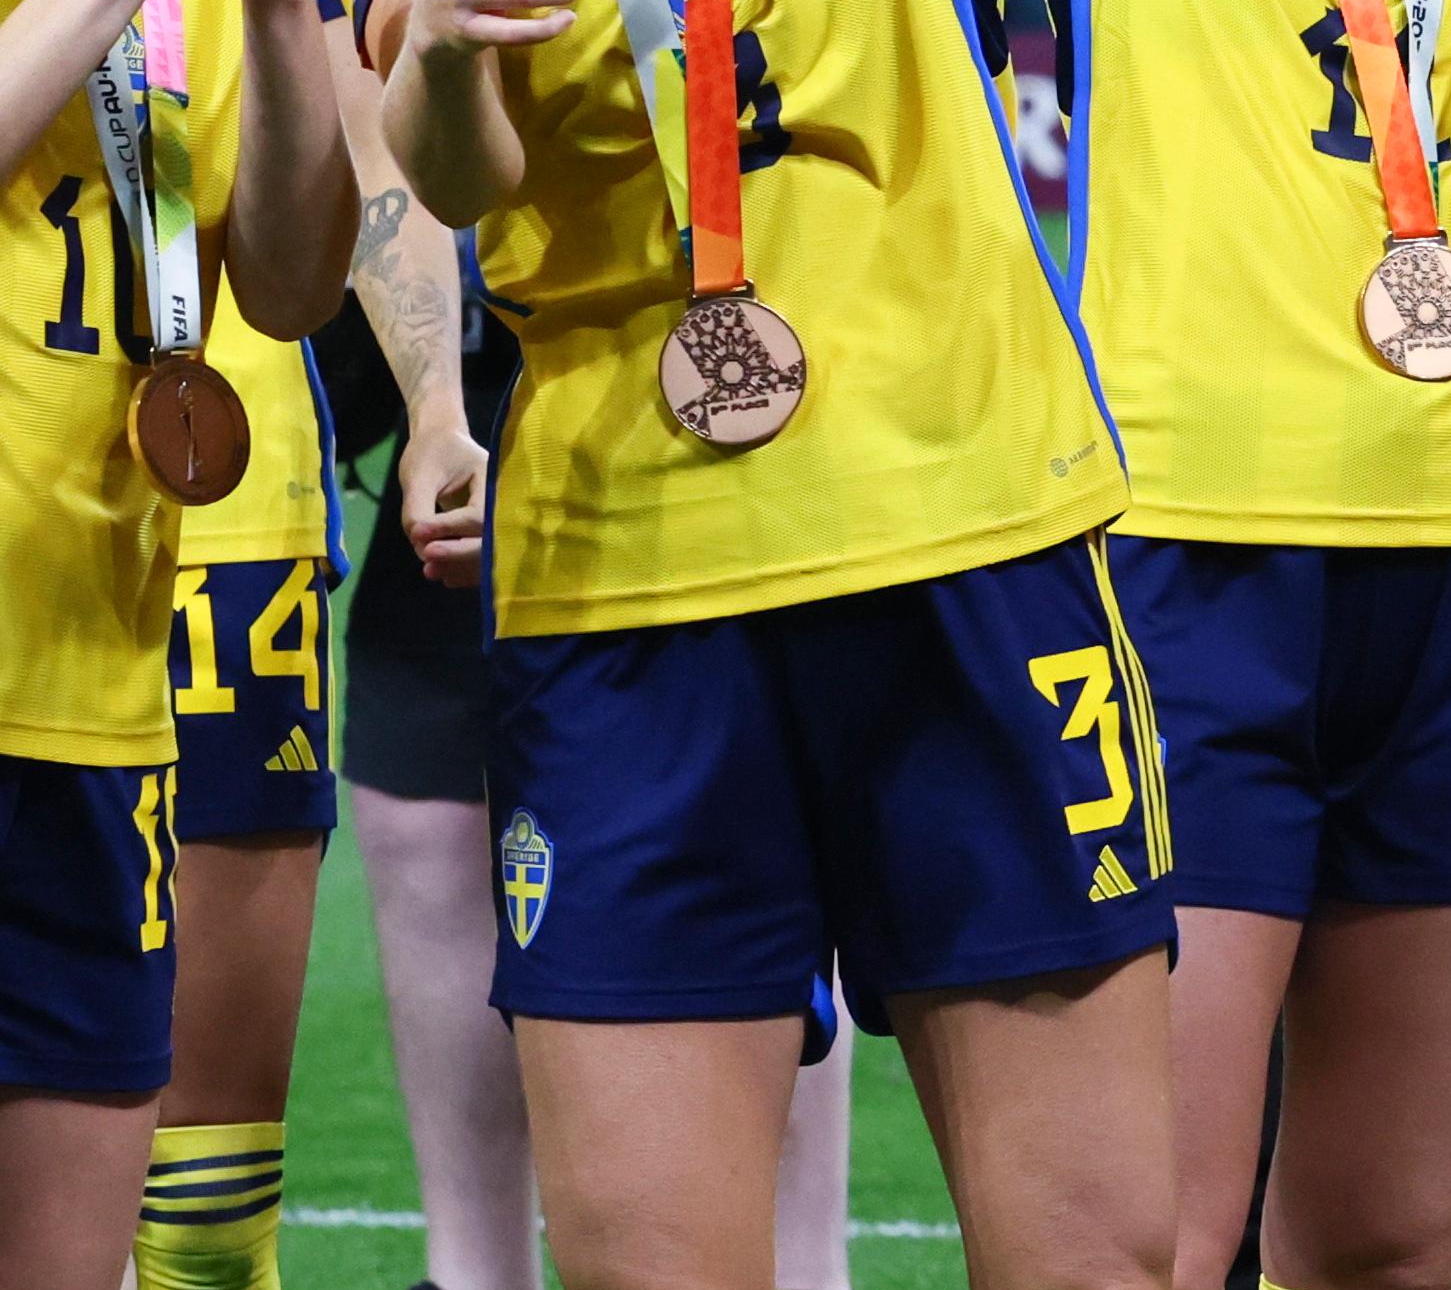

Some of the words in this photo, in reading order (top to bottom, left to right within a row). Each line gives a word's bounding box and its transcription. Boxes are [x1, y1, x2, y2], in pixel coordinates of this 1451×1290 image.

[171, 295, 188, 343] FIFA
[173, 560, 320, 715] 14
[1028, 645, 1133, 836] 3
